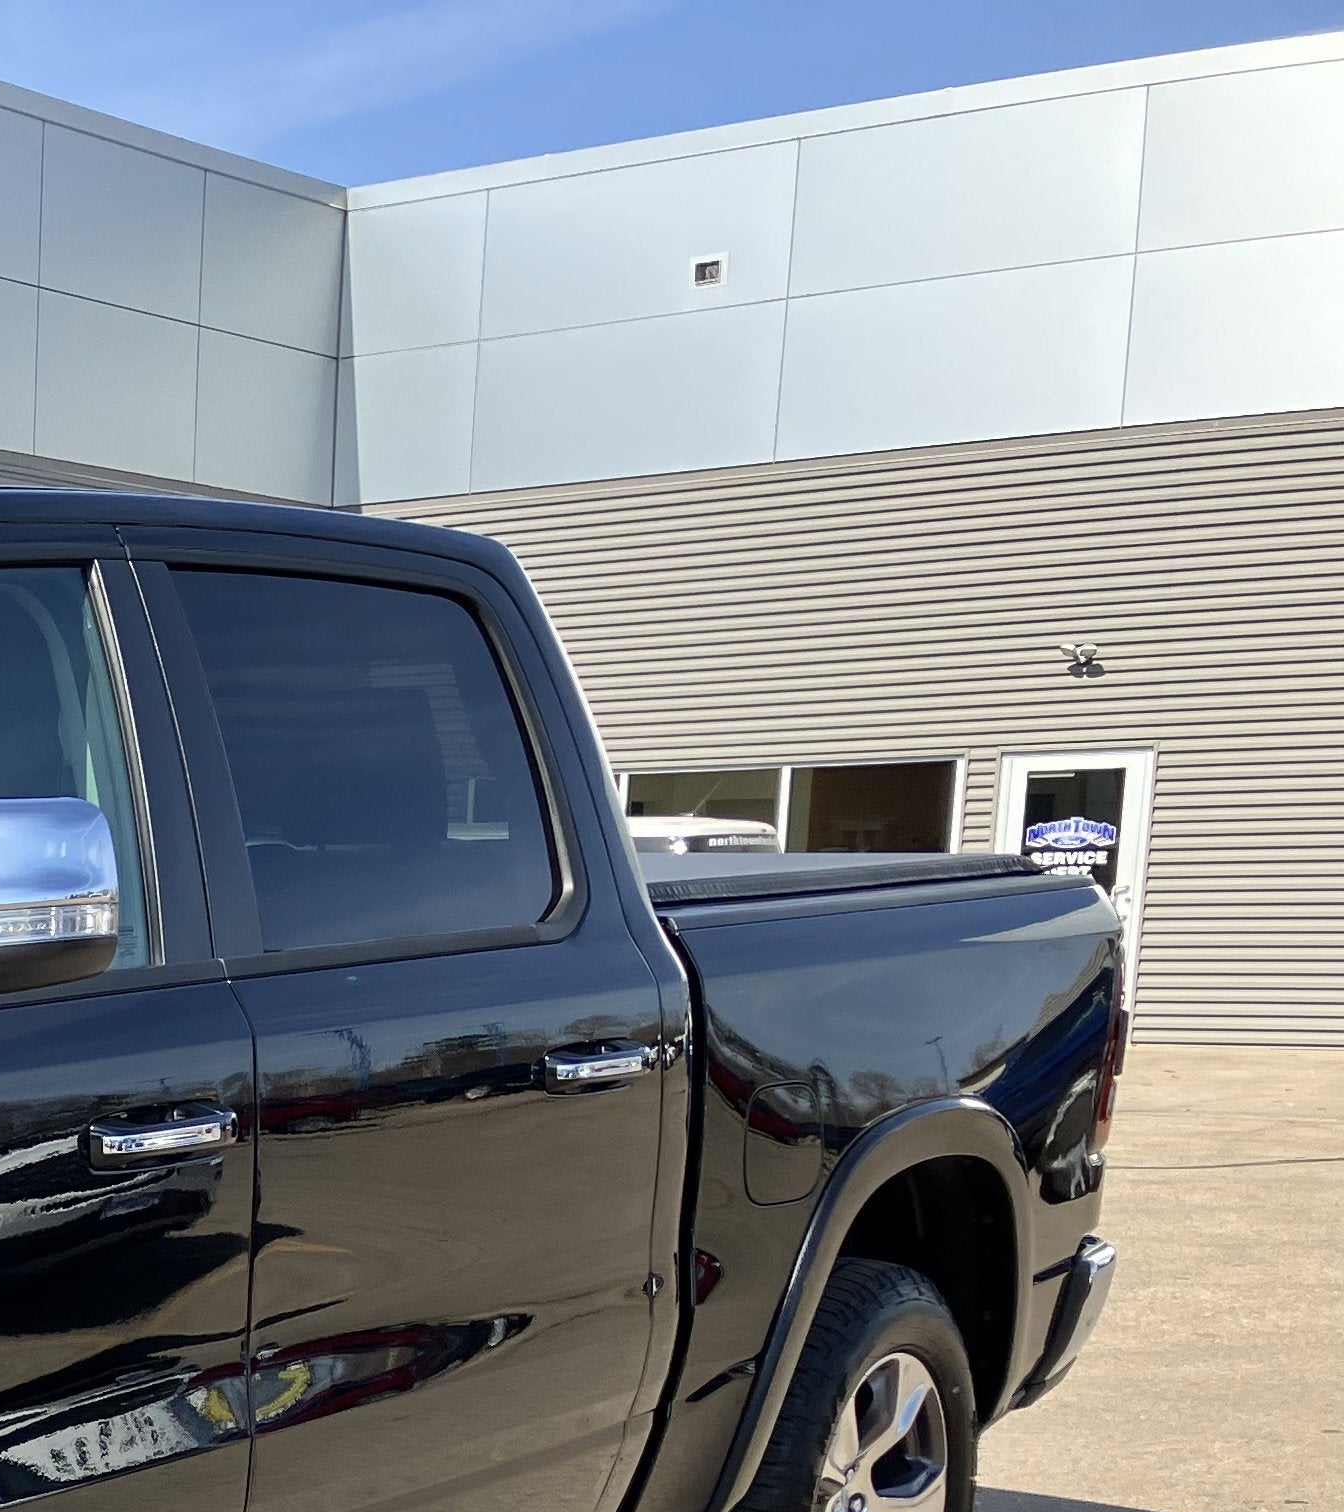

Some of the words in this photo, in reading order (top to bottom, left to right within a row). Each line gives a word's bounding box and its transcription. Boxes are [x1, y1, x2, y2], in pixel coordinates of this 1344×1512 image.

[1028, 821, 1072, 843] NORTH
[1073, 819, 1115, 842] TOWN
[1031, 851, 1109, 866] SERVICE
